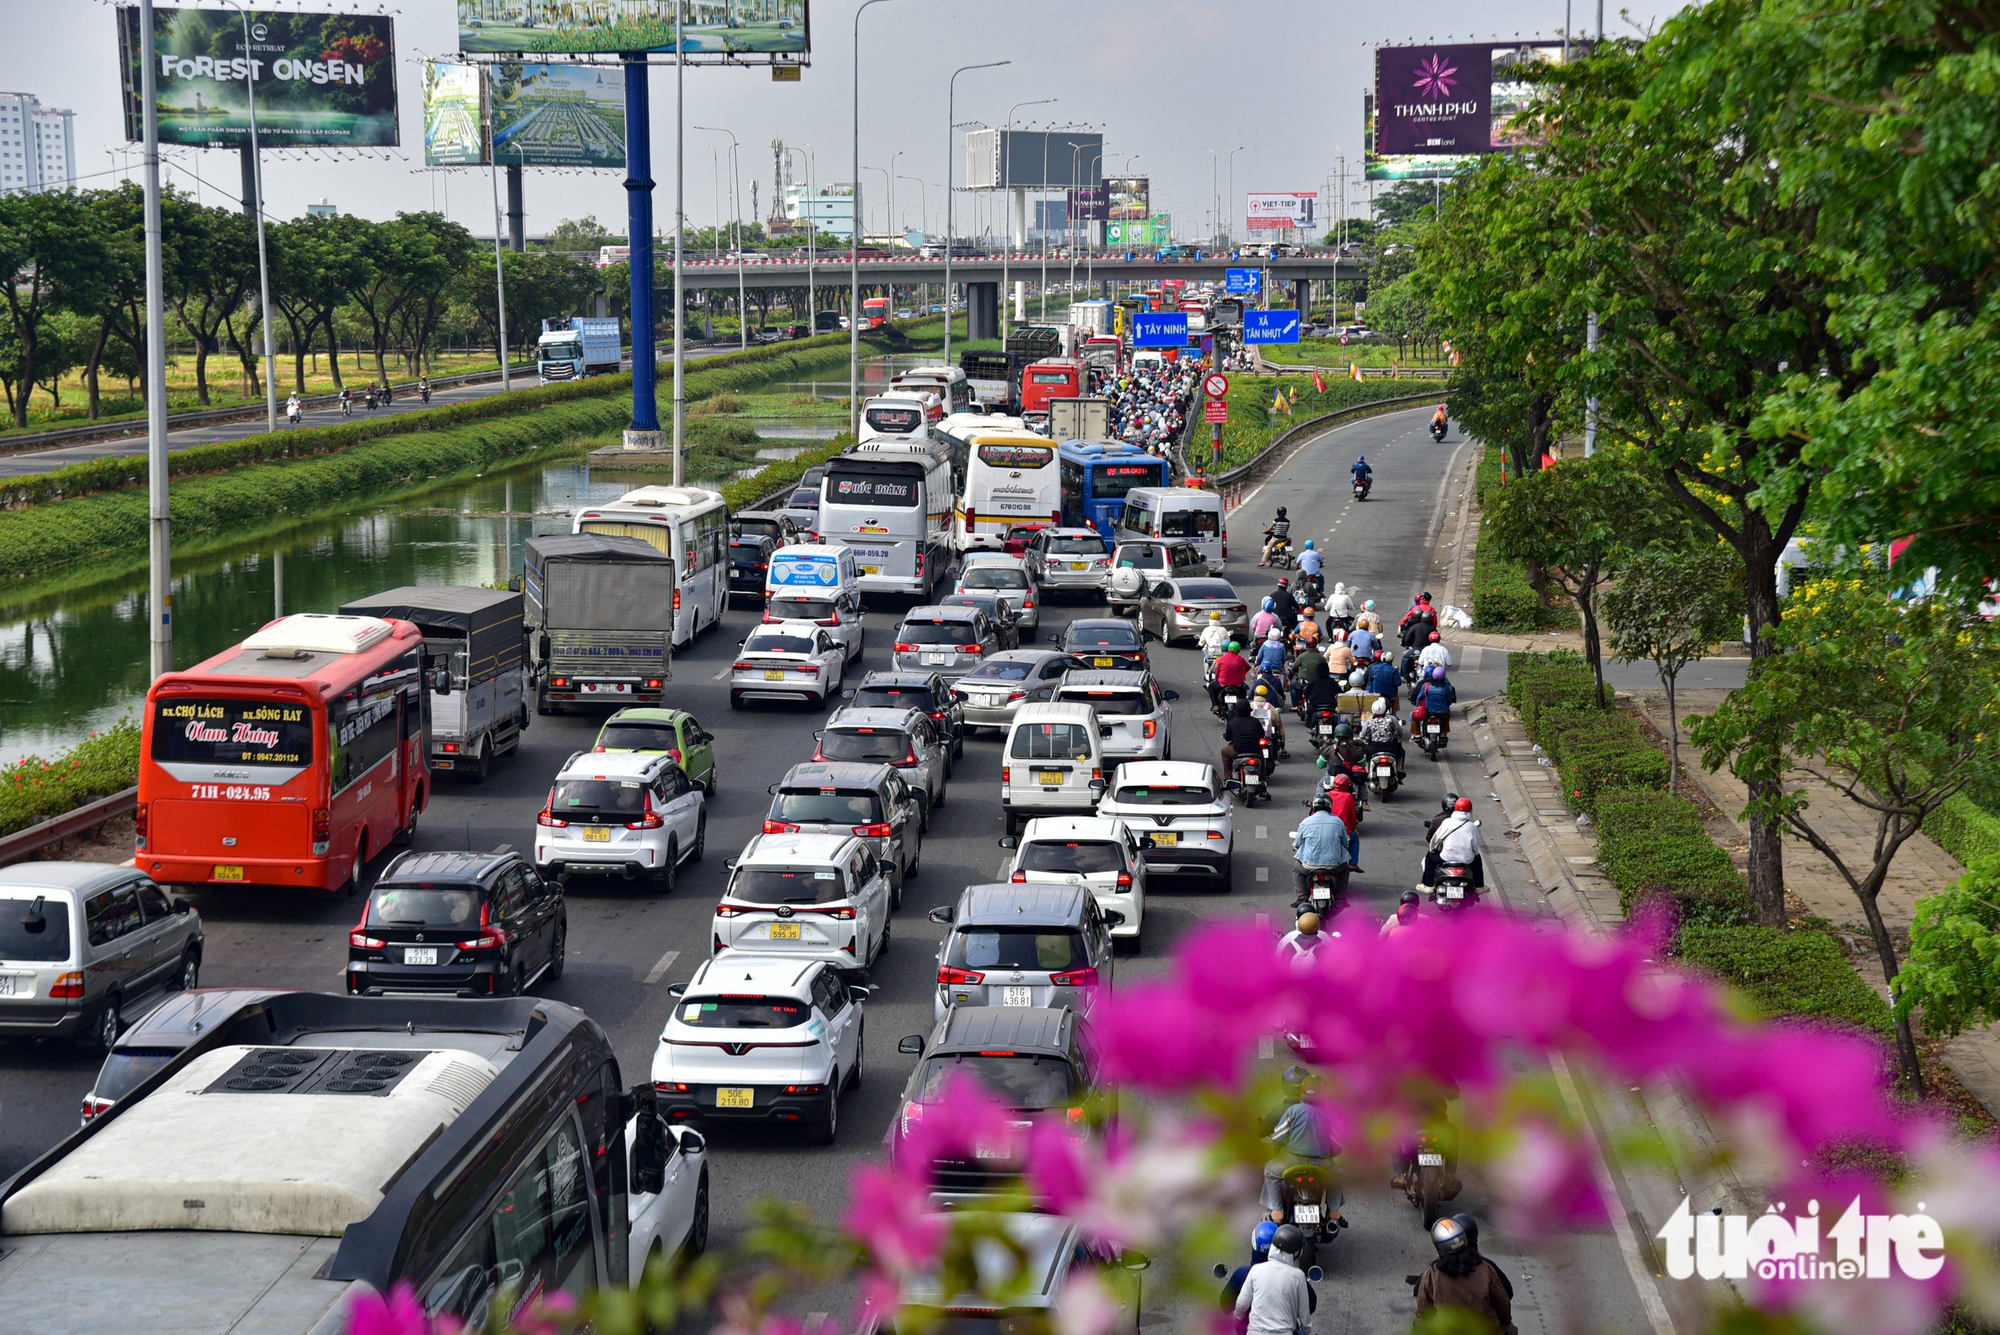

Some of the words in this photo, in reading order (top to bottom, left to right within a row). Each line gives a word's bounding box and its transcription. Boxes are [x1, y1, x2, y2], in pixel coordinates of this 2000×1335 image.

[252, 44, 286, 52] RETREAT
[162, 55, 263, 81] FOREST
[272, 59, 364, 85] ONSEN
[1394, 103, 1443, 117] THANH
[1445, 100, 1477, 115] PHÚ
[1413, 115, 1437, 123] CENTRE
[1441, 138, 1455, 146] Land
[1144, 323, 1161, 335] TÂY
[1163, 324, 1186, 335] NINH
[1246, 327, 1260, 339] TÂN
[874, 483, 908, 496] HOÀNG
[853, 549, 889, 558] 66H-059.20
[162, 704, 196, 720] BX.CHỢ
[198, 703, 225, 719] LÁCH
[242, 706, 281, 721] BX.SÔNG
[282, 709, 302, 722] RAY
[231, 722, 279, 748] Hưng
[772, 931, 797, 939] 595.35
[414, 948, 428, 956] 51H
[408, 956, 434, 964] 833.39
[1010, 987, 1025, 996] 51G
[1004, 996, 1029, 1006] 436.81
[728, 1090, 743, 1098] 50E
[721, 1098, 749, 1106] 219.80
